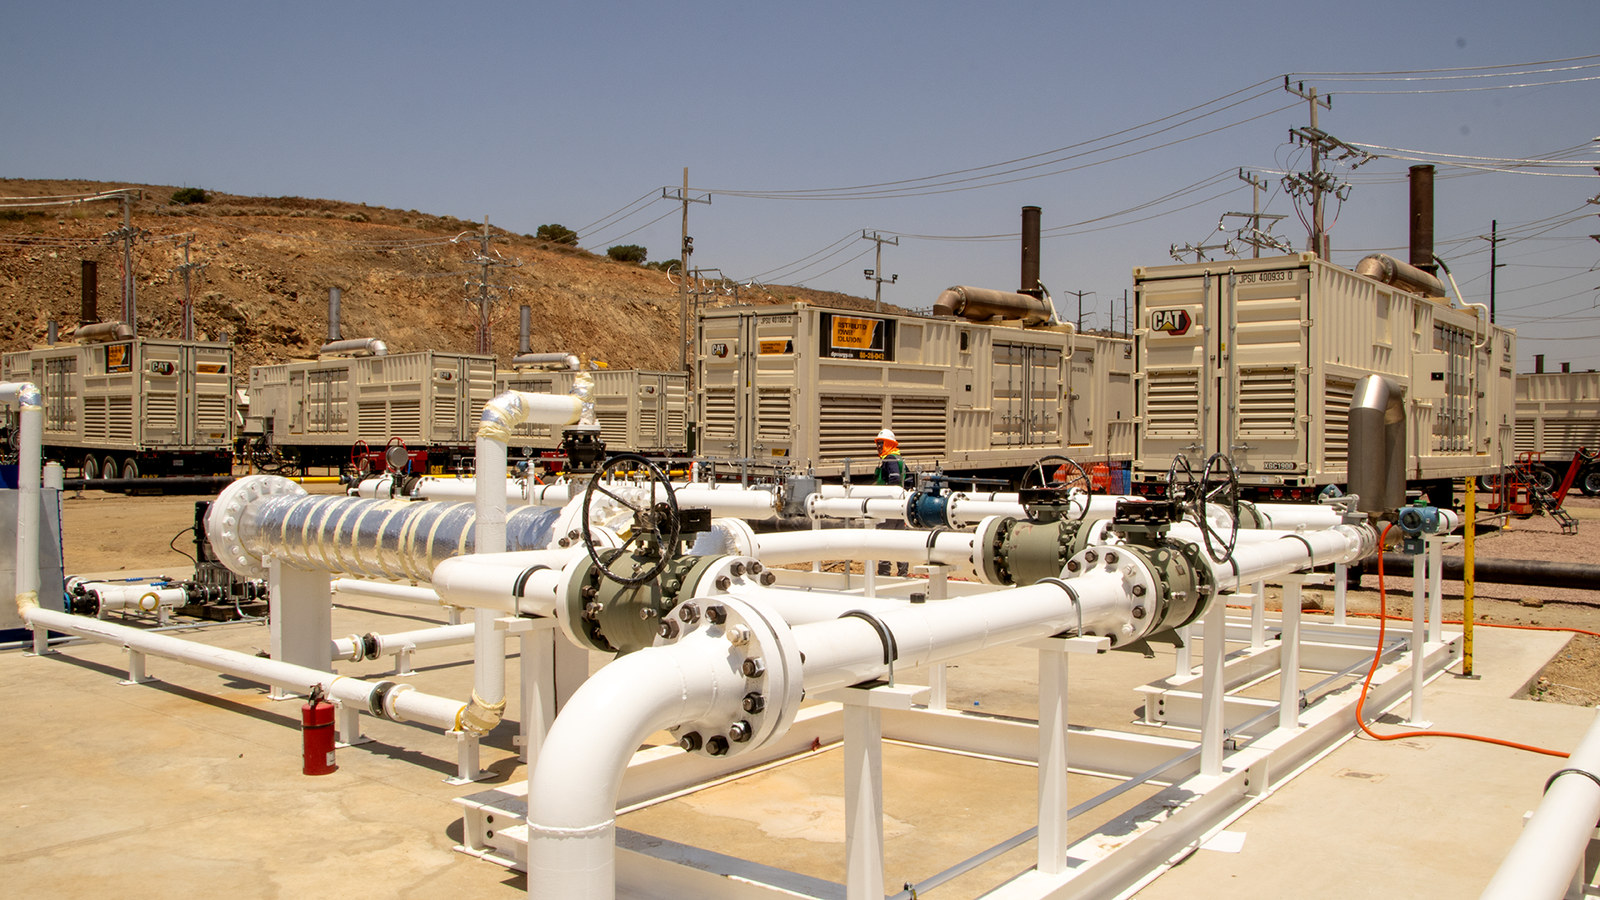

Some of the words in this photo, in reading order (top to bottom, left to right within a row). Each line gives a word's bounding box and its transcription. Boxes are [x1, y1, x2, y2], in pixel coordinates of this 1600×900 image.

[1239, 274, 1256, 284] JPSU
[1259, 271, 1285, 282] 400933
[1152, 310, 1182, 331] CAT
[712, 344, 725, 355] CAT
[152, 361, 169, 373] CAT
[430, 465, 443, 475] CAT
